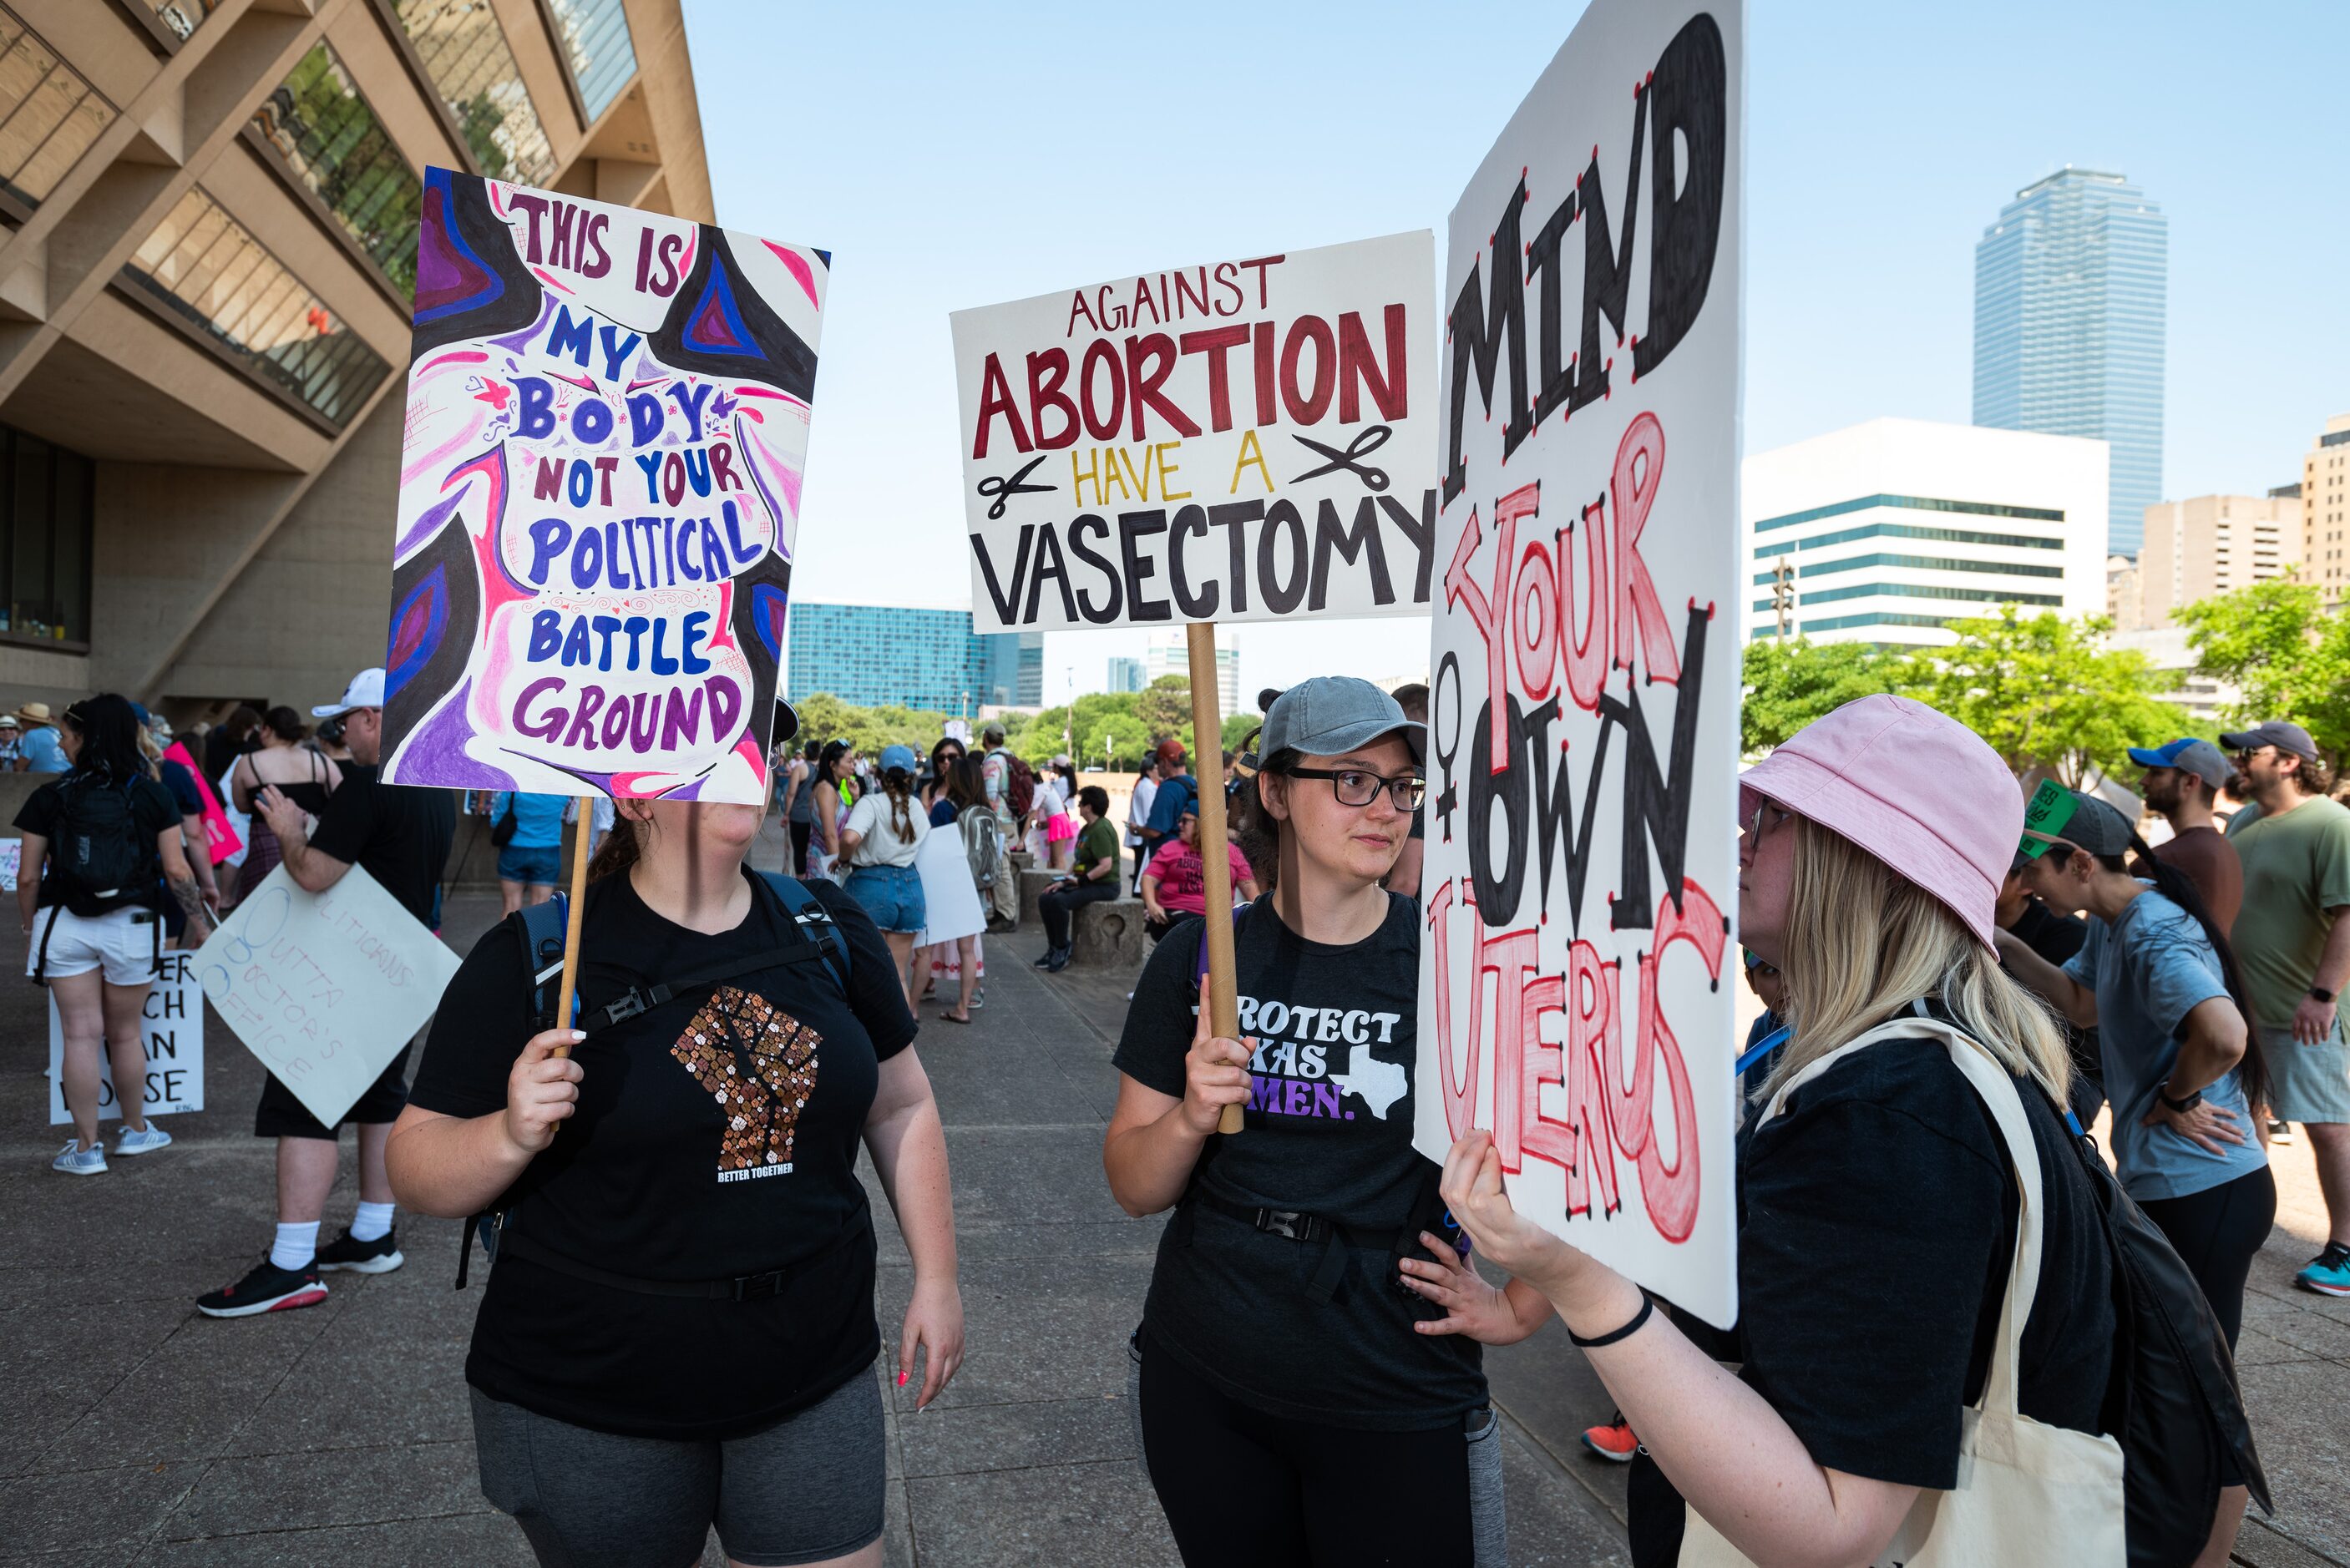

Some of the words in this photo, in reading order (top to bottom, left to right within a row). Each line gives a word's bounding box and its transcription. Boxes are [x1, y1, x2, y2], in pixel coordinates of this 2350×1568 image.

[508, 192, 612, 280] THIS
[635, 226, 686, 298] IS
[1440, 12, 1727, 513] MIND
[1066, 253, 1286, 338] AGAINST
[545, 304, 641, 382] MY
[972, 303, 1408, 459] ABORTION
[506, 377, 713, 446] BODY
[533, 455, 620, 507] NOT
[636, 441, 744, 503] YOUR
[1071, 440, 1192, 508] HAVE
[1229, 429, 1275, 494] A
[528, 500, 762, 590] POLITICAL
[969, 489, 1436, 625] VASECTOMY
[1444, 411, 1684, 775] YOUR
[525, 609, 712, 675] BATTLE
[512, 675, 744, 751] GROUND
[1468, 598, 1716, 938] OWN
[200, 964, 313, 1081] OFFICE
[1237, 995, 1401, 1044] ROTECT
[1239, 1035, 1327, 1079] XAS
[1427, 876, 1730, 1244] UTERUS
[1246, 1075, 1355, 1120] MEN.
[717, 1169, 750, 1183] BETTER
[751, 1162, 793, 1179] TOGETHER
